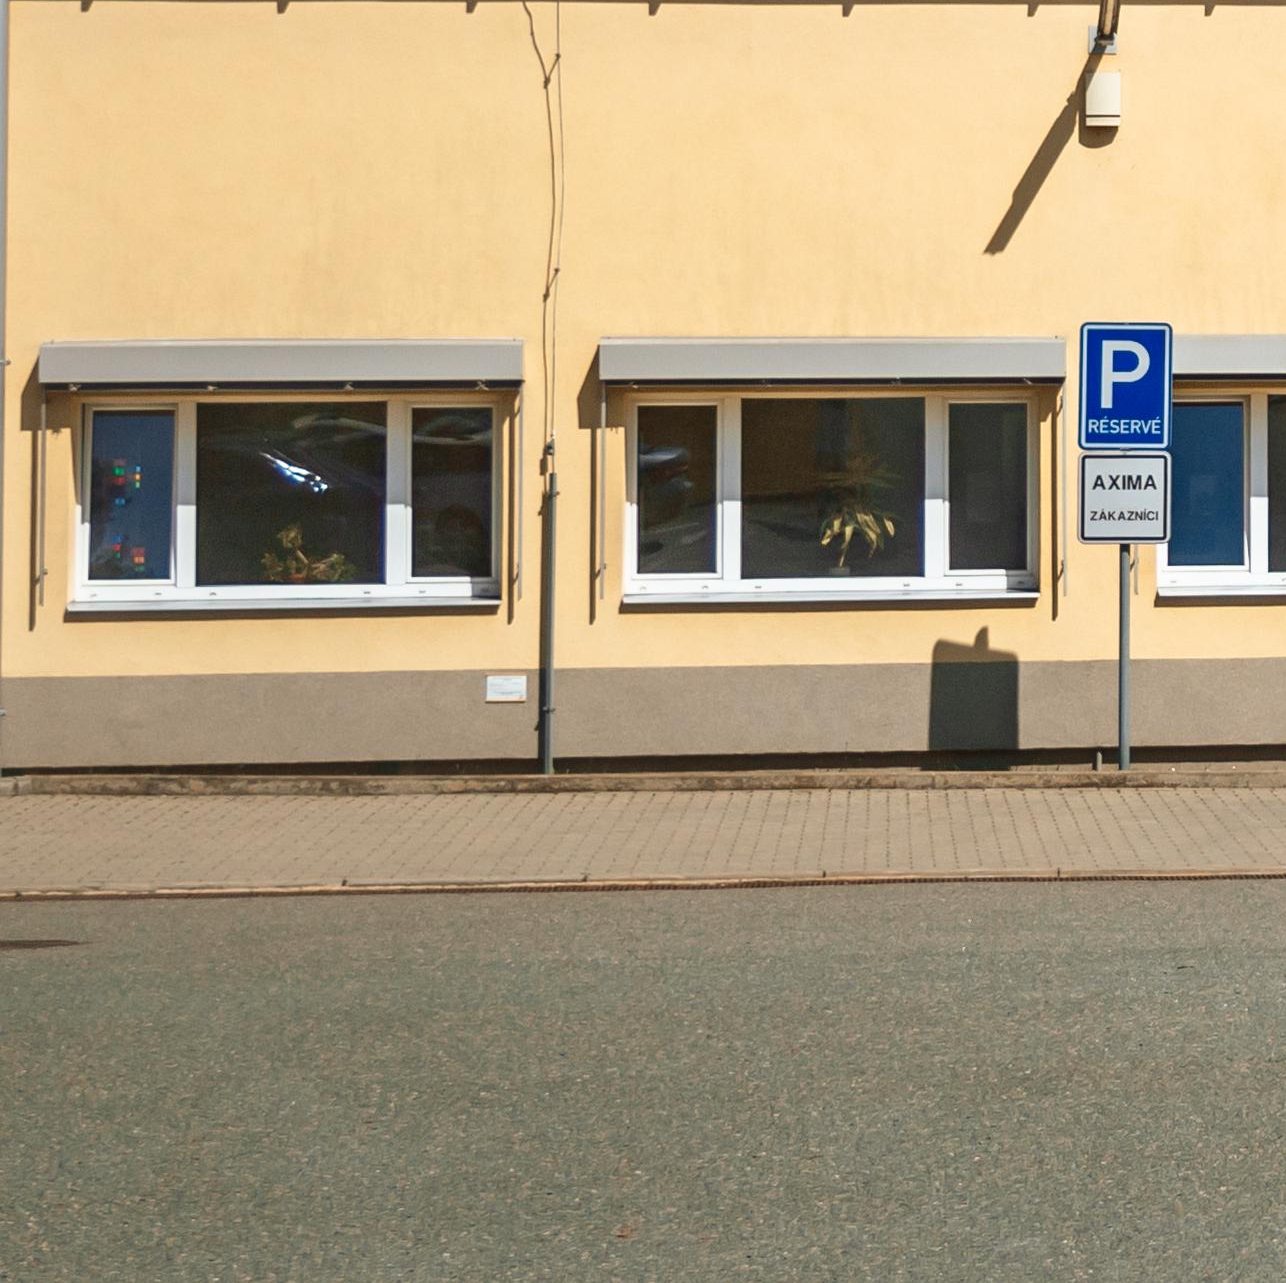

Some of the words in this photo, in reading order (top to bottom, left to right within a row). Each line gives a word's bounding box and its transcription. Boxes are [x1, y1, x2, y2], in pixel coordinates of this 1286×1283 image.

[1101, 340, 1151, 409] P
[1088, 416, 1162, 434] RÉSERVÉ
[1092, 475, 1158, 490] AXIMA
[1090, 509, 1159, 521] ZÁKAZNÍCI
